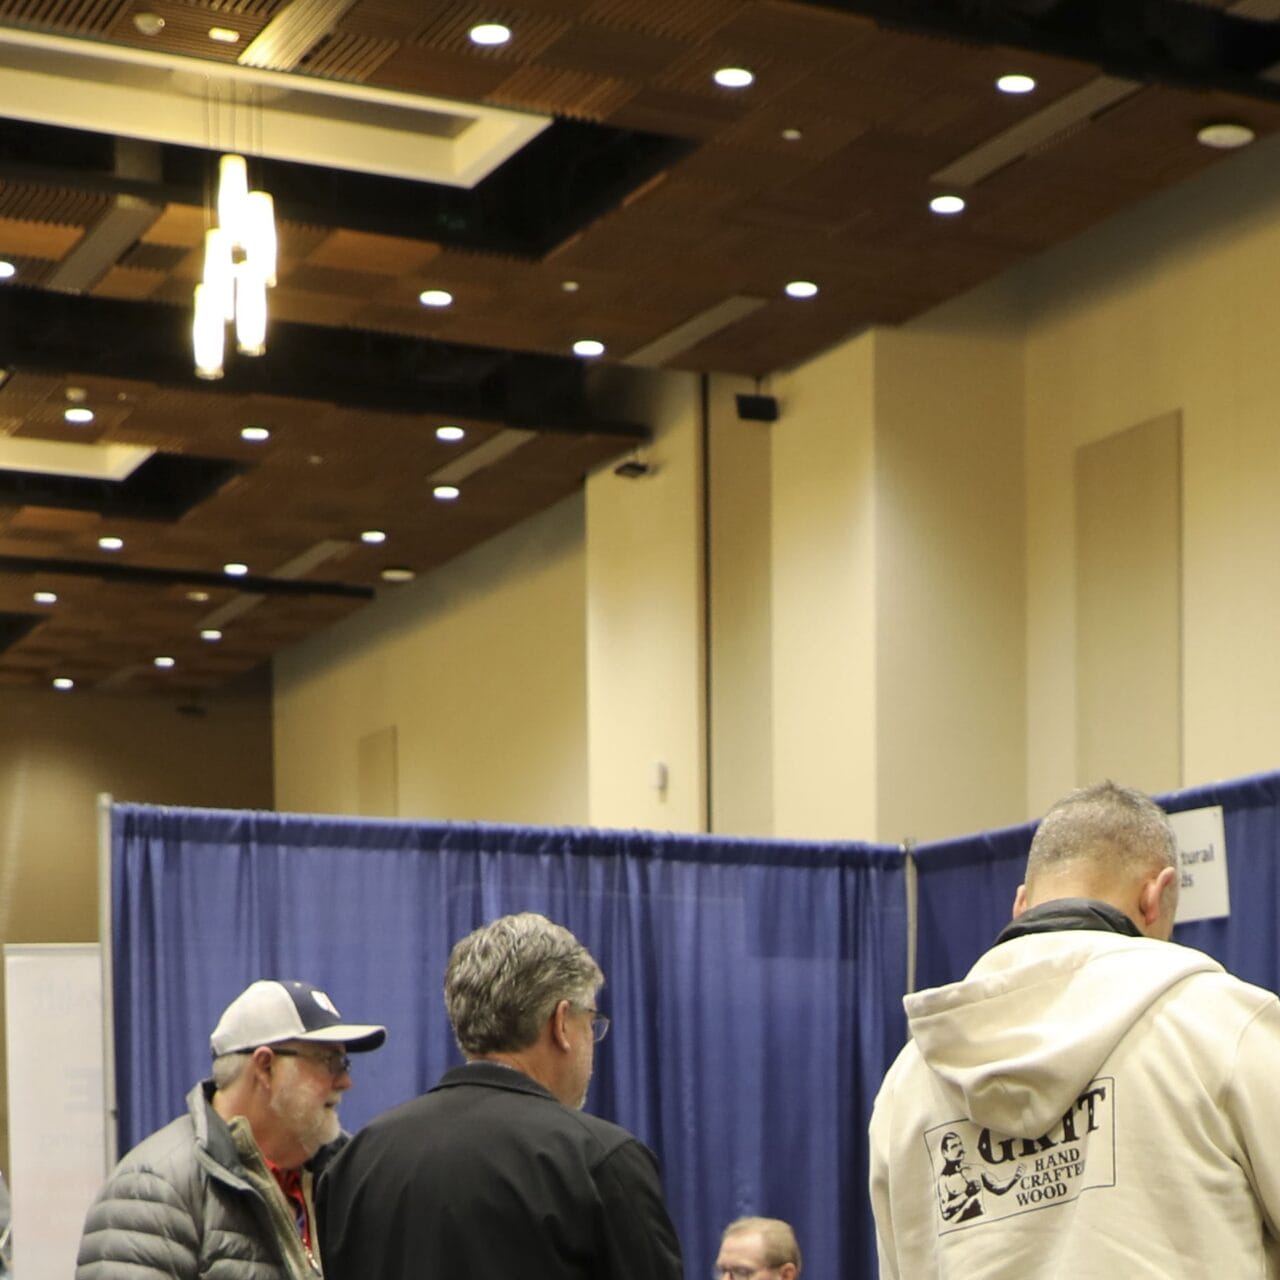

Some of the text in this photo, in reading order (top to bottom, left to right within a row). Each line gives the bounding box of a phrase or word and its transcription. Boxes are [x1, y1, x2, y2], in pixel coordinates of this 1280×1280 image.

[977, 1087, 1106, 1164] GIT
[1034, 1147, 1080, 1172] HAND
[1019, 1160, 1085, 1190] CRAFTE
[1016, 1182, 1067, 1207] WOOD
